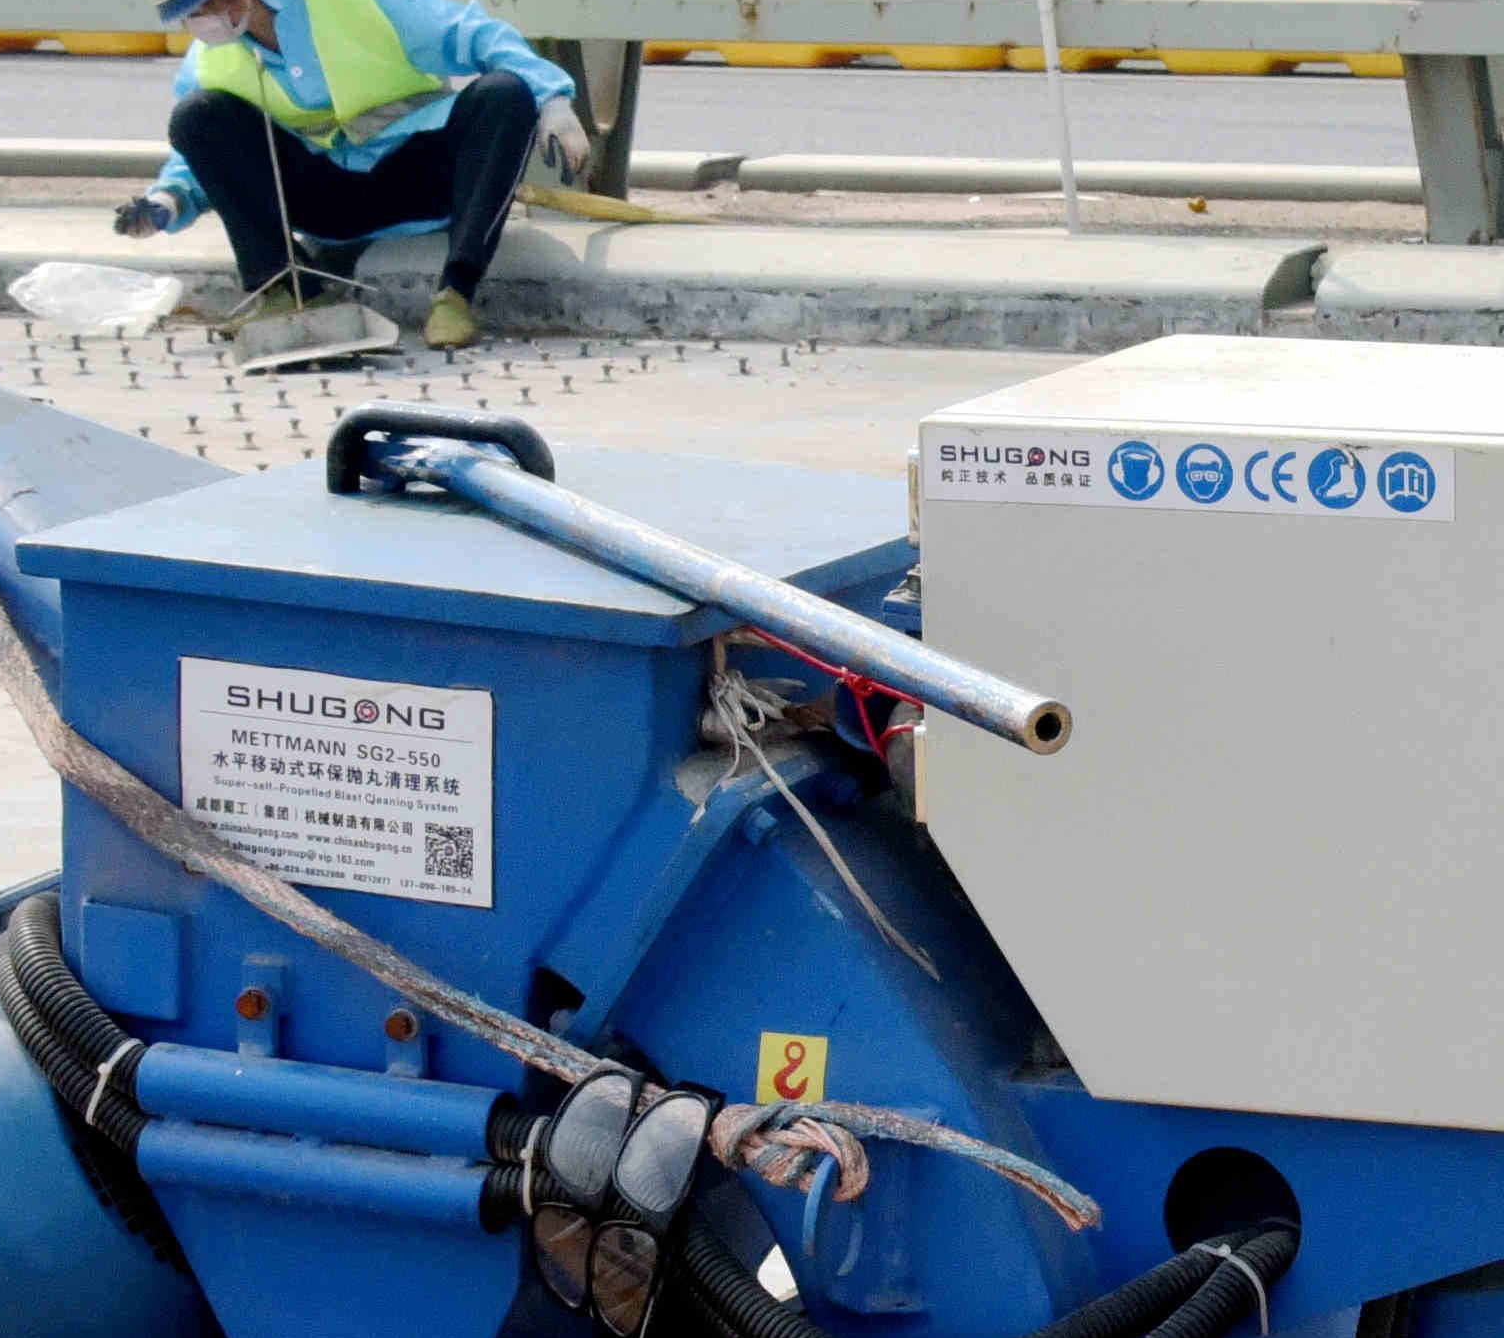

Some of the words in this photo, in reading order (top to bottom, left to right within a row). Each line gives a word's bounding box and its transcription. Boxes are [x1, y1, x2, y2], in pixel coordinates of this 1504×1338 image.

[940, 445, 1091, 467] SHUGONG
[941, 468, 1007, 485] 纯正技术
[1025, 471, 1091, 487] 品质保证
[1245, 450, 1297, 503] CE
[227, 685, 445, 730] SHUGONG
[231, 729, 346, 757] METTMANN
[357, 744, 441, 768] SG2-550
[212, 750, 460, 796] 水平移动式环保抛丸清理系统
[335, 789, 362, 802] Blast
[365, 793, 414, 810] Cleaning
[417, 799, 459, 813] System
